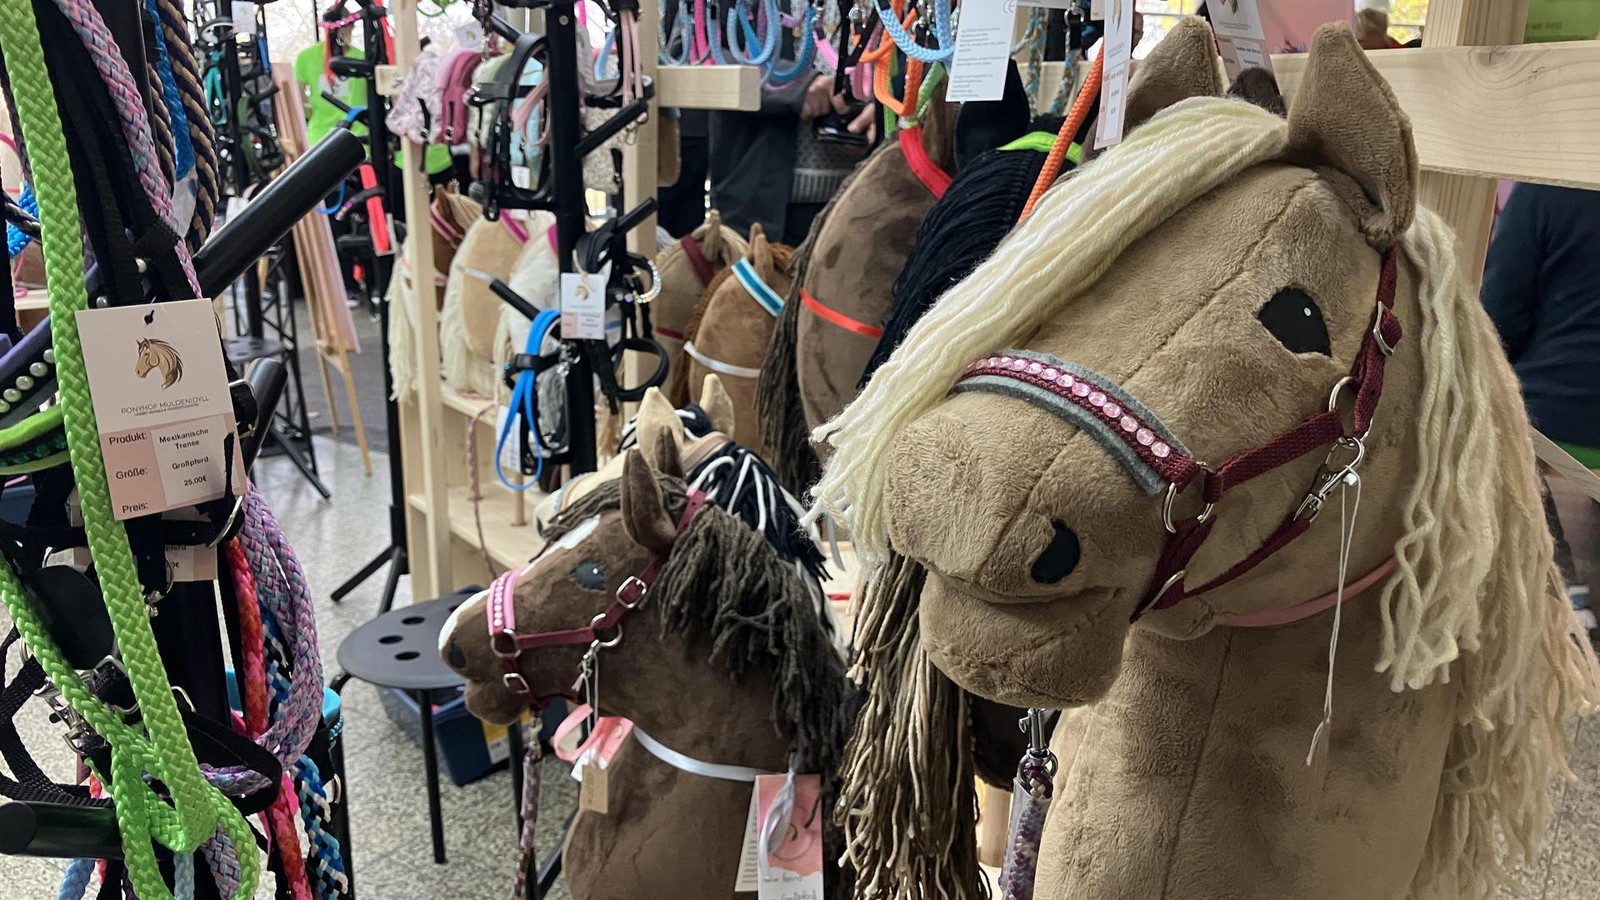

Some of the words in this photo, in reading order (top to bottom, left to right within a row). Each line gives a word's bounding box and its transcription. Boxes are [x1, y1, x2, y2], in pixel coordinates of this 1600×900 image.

[121, 403, 158, 414] PONYHOF
[159, 395, 210, 408] MULDENIDYLL
[108, 432, 148, 445] Produkt:
[159, 428, 209, 443] Mexikanische
[175, 440, 200, 450] Trense
[171, 456, 209, 470] Großpferd
[115, 467, 148, 480] Größe:
[121, 502, 149, 514] Preis:
